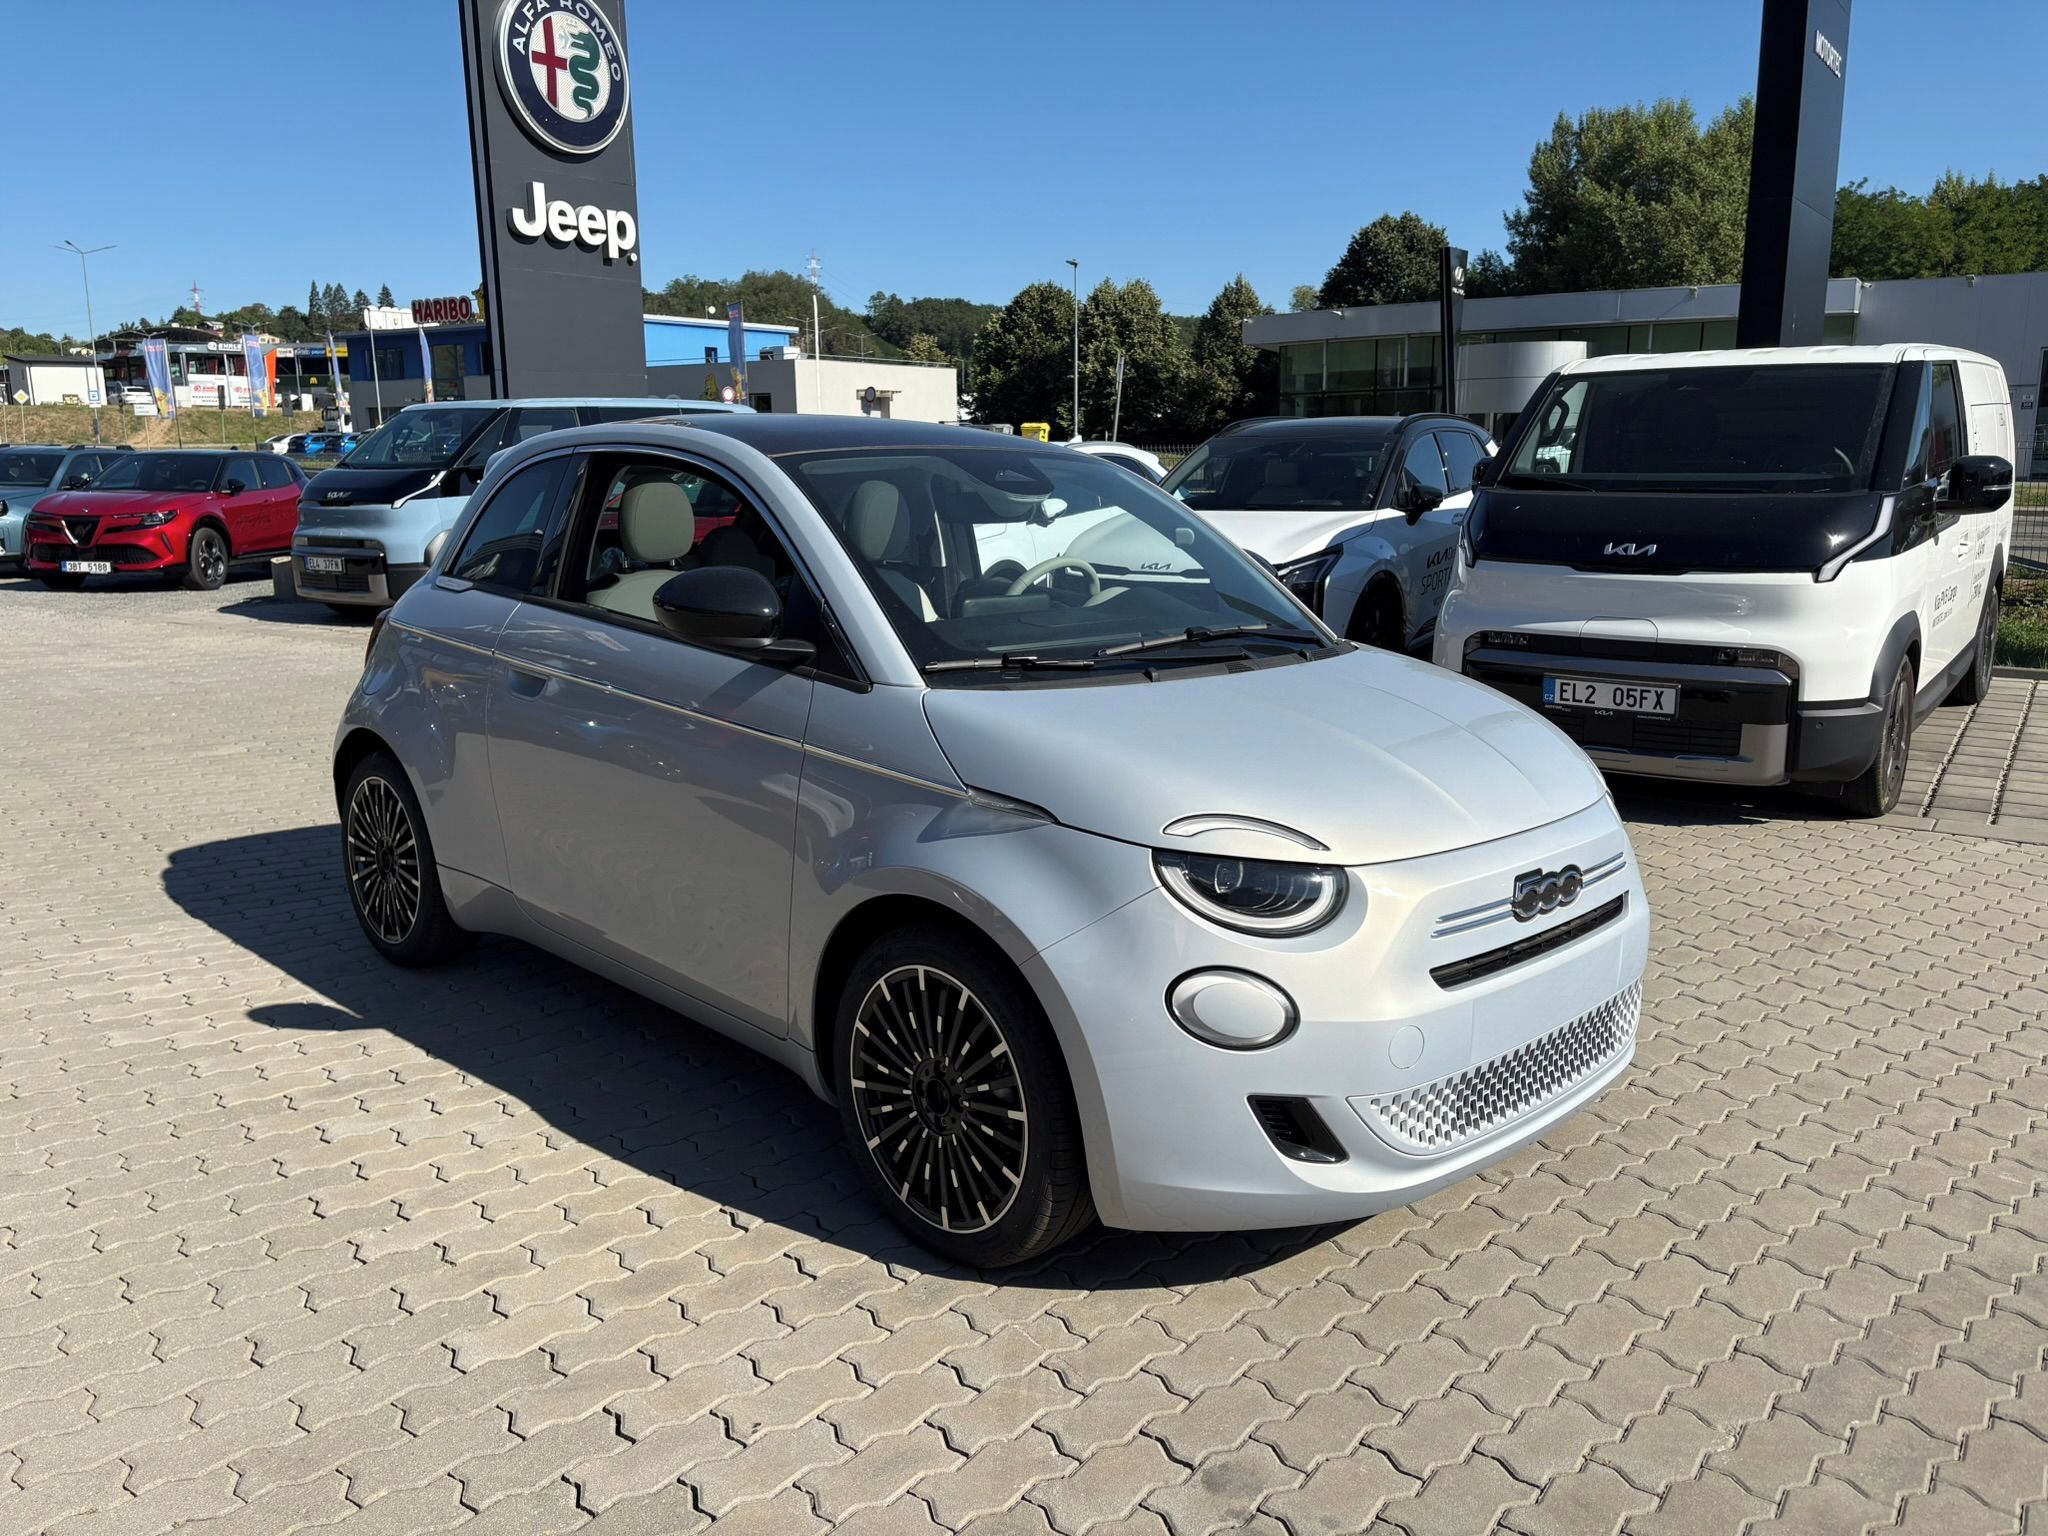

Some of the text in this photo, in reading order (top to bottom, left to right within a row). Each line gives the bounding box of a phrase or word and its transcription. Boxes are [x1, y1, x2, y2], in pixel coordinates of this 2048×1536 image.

[512, 0, 621, 81] ALFA ROMEO
[411, 296, 472, 323] HARIBO
[1603, 542, 1657, 556] KIA
[1544, 693, 1554, 701] CZ
[1559, 682, 1664, 711] EL2 05FX
[1512, 866, 1583, 922] 500
